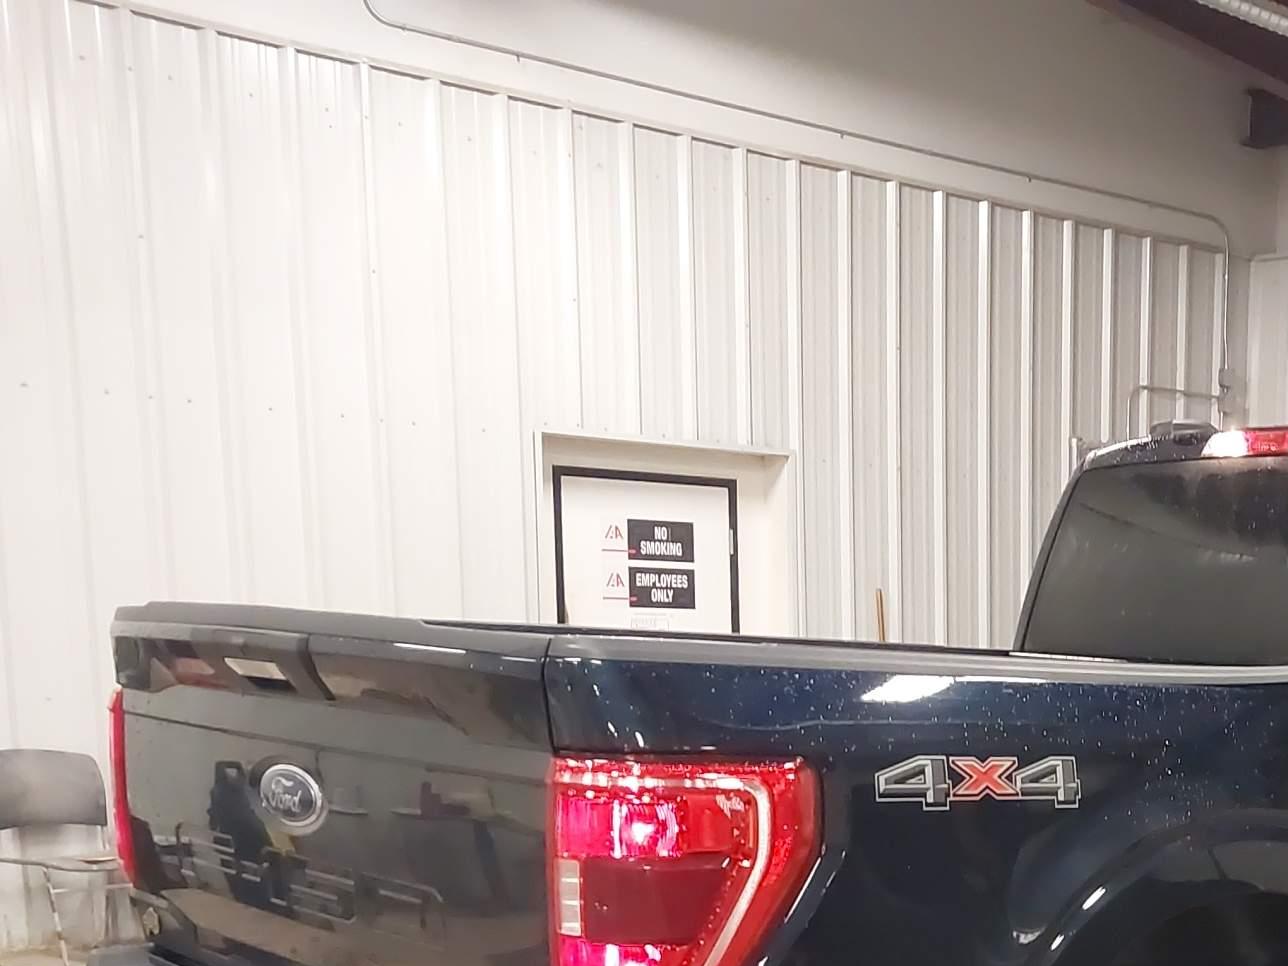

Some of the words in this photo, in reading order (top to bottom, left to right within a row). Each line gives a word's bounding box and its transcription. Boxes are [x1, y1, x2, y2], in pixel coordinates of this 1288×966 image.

[654, 526, 668, 540] NO
[640, 541, 683, 556] SMOKING
[635, 573, 688, 588] EMPLOYEES
[651, 588, 674, 603] ONLY
